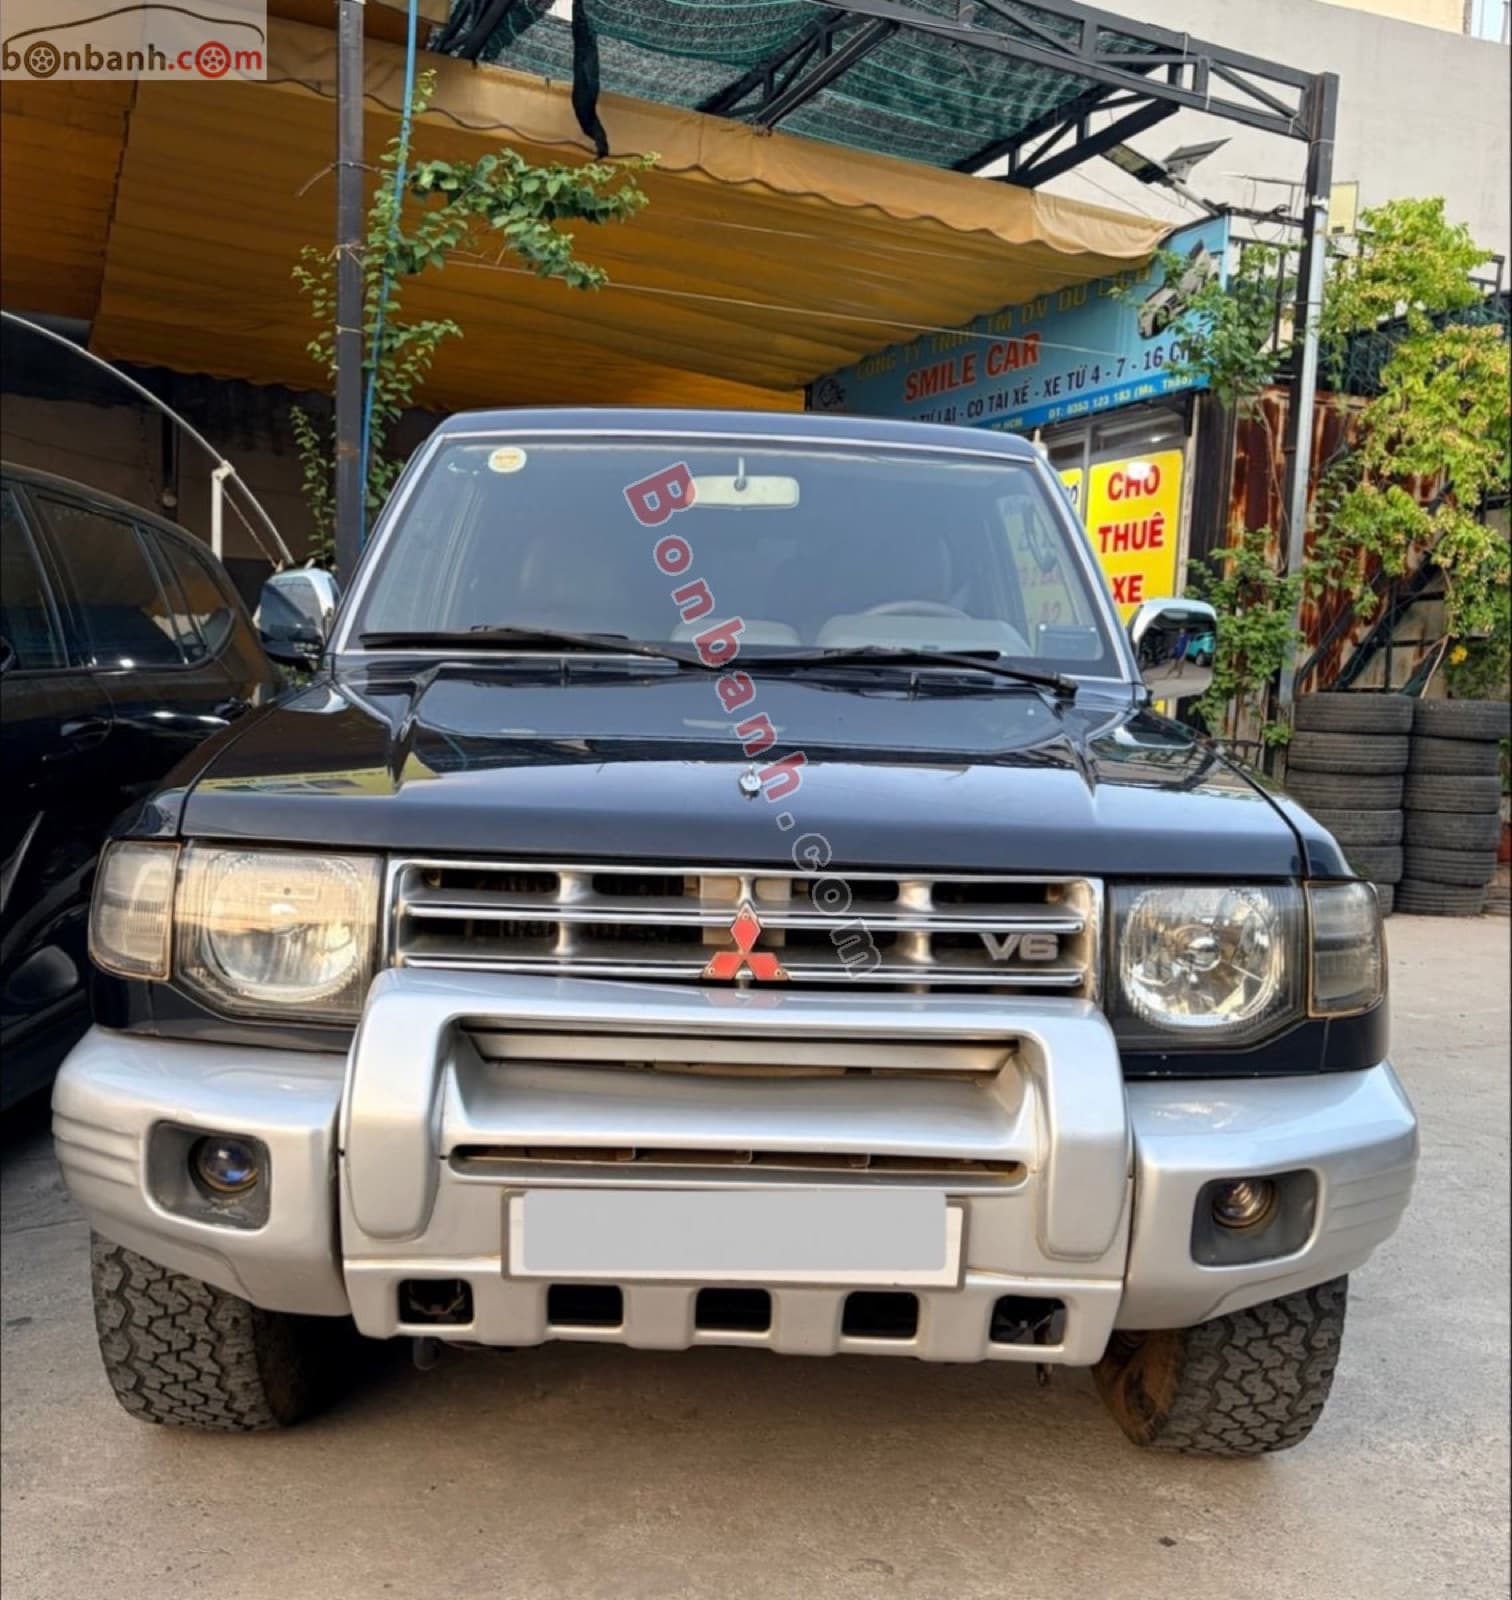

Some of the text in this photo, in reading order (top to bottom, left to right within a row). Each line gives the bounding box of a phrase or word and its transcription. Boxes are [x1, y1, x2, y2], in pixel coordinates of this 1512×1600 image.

[904, 332, 1041, 402] SMILE CAR
[1043, 376, 1061, 398] XE
[1090, 365, 1100, 385] 4
[1116, 357, 1126, 379] 7
[1144, 345, 1164, 371] 16
[1107, 465, 1161, 500] CHO
[1098, 512, 1165, 554] THUÊ
[1111, 575, 1143, 604] XE
[979, 933, 1059, 960] V6
